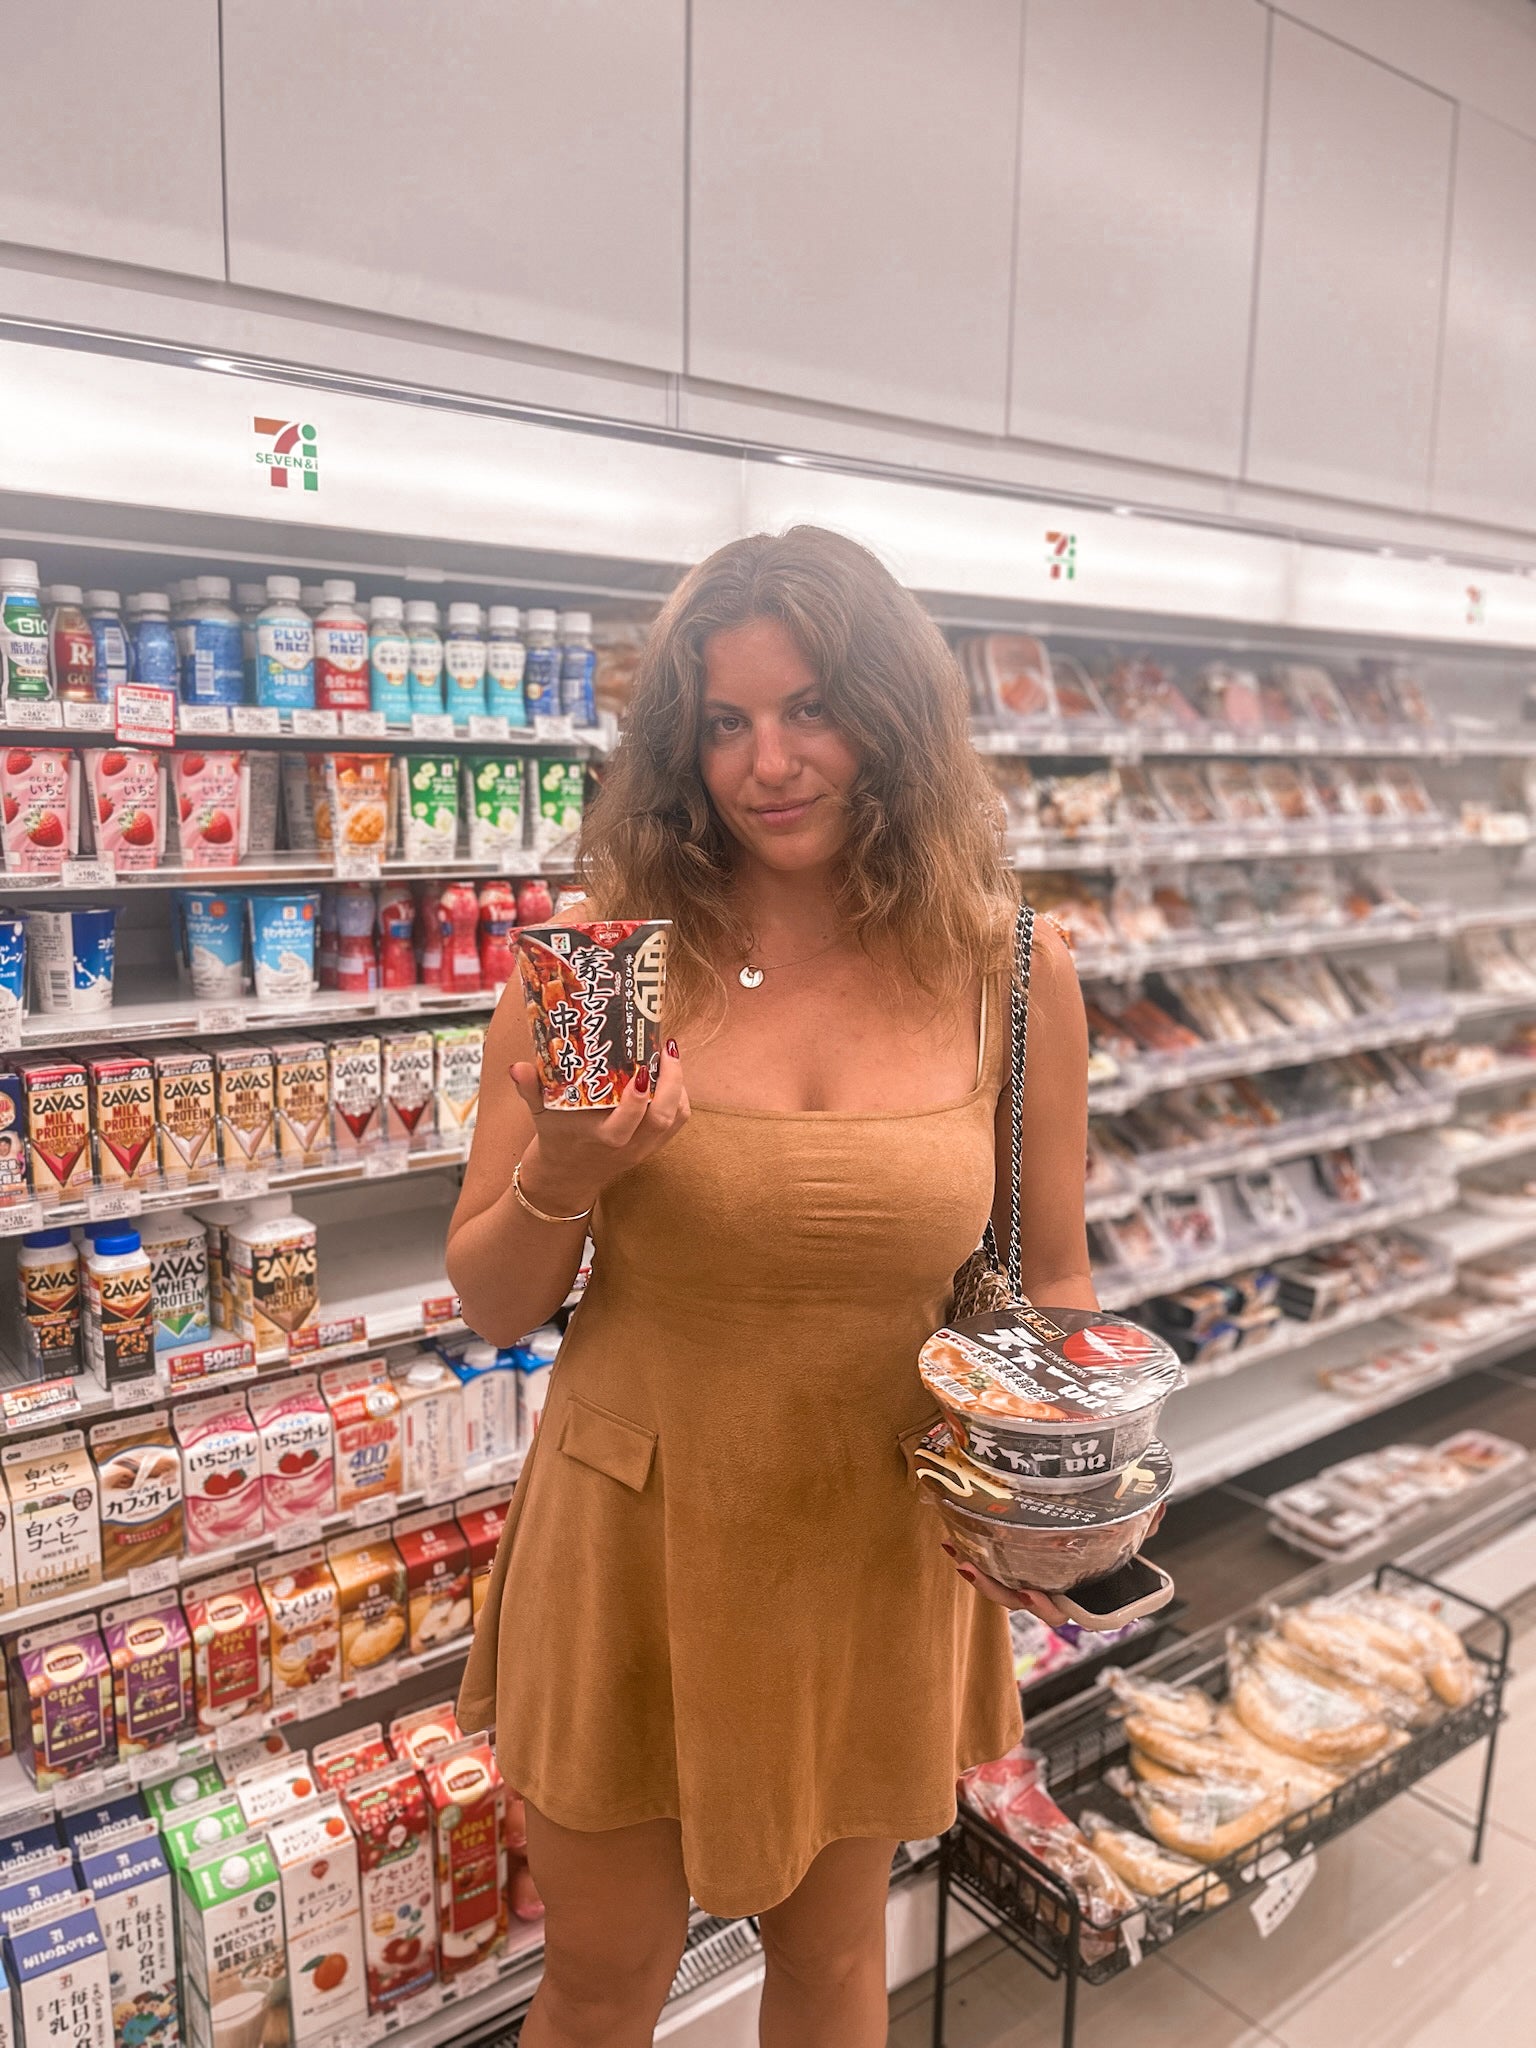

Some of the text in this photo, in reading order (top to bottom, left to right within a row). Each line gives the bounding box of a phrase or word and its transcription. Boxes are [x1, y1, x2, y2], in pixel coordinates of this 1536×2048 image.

[30, 784, 64, 797] いちご
[123, 784, 155, 797] いちご
[202, 785, 233, 797] いちご
[624, 953, 635, 1060] 辛さの中に旨みあり
[570, 945, 615, 1101] 蒙古タンメン
[550, 1002, 584, 1080] 中本
[336, 1059, 378, 1079] SAVAS
[390, 1055, 430, 1074] SAVAS
[443, 1050, 482, 1068] SAVAS
[225, 1073, 270, 1092] SAVAS
[282, 1066, 326, 1086] SAVAS
[102, 1087, 151, 1108] SAVAS
[164, 1079, 212, 1100] SAVAS
[235, 1090, 261, 1103] MILK
[291, 1084, 315, 1096] MILK
[33, 1094, 86, 1115] SAVAS
[113, 1104, 141, 1118] MILK
[174, 1098, 201, 1111] MILK
[228, 1101, 270, 1116] PROTEIN
[284, 1094, 325, 1108] PROTEIN
[45, 1111, 75, 1125] MILK
[104, 1115, 152, 1132] PROTEIN
[166, 1108, 211, 1124] PROTEIN
[36, 1123, 86, 1140] PROTEIN
[256, 1249, 318, 1284] SAVAS
[27, 1269, 78, 1292] SAVAS
[102, 1276, 150, 1300] SAVAS
[156, 1277, 199, 1296] WHEY
[152, 1286, 208, 1309] PROTEIN
[977, 1327, 1124, 1409] 天下一品
[1042, 1347, 1090, 1379] TENKAIPPIN
[265, 1423, 329, 1451] いちごオーレ
[189, 1442, 256, 1472] いちごオーレ
[350, 1442, 388, 1470] 400
[969, 1426, 1107, 1473] 天下一品
[24, 1461, 70, 1481] 白バラ
[25, 1473, 76, 1494] コーヒー
[106, 1487, 181, 1517] カフェオーレ
[26, 1512, 80, 1539] 白バラ
[27, 1529, 88, 1553] コーヒー
[275, 1589, 334, 1622] よくばり
[222, 1642, 246, 1655] TEA
[130, 1652, 176, 1674] GRAPE
[141, 1667, 167, 1681] TEA
[47, 1677, 96, 1702] GRAPE
[60, 1694, 86, 1708] TEA
[461, 1834, 487, 1850] TEA
[293, 1889, 352, 1929] オレンジ
[116, 1917, 133, 1951] 牛乳
[136, 1909, 155, 1985] 毎日の食卓
[48, 1998, 69, 2036] 牛乳
